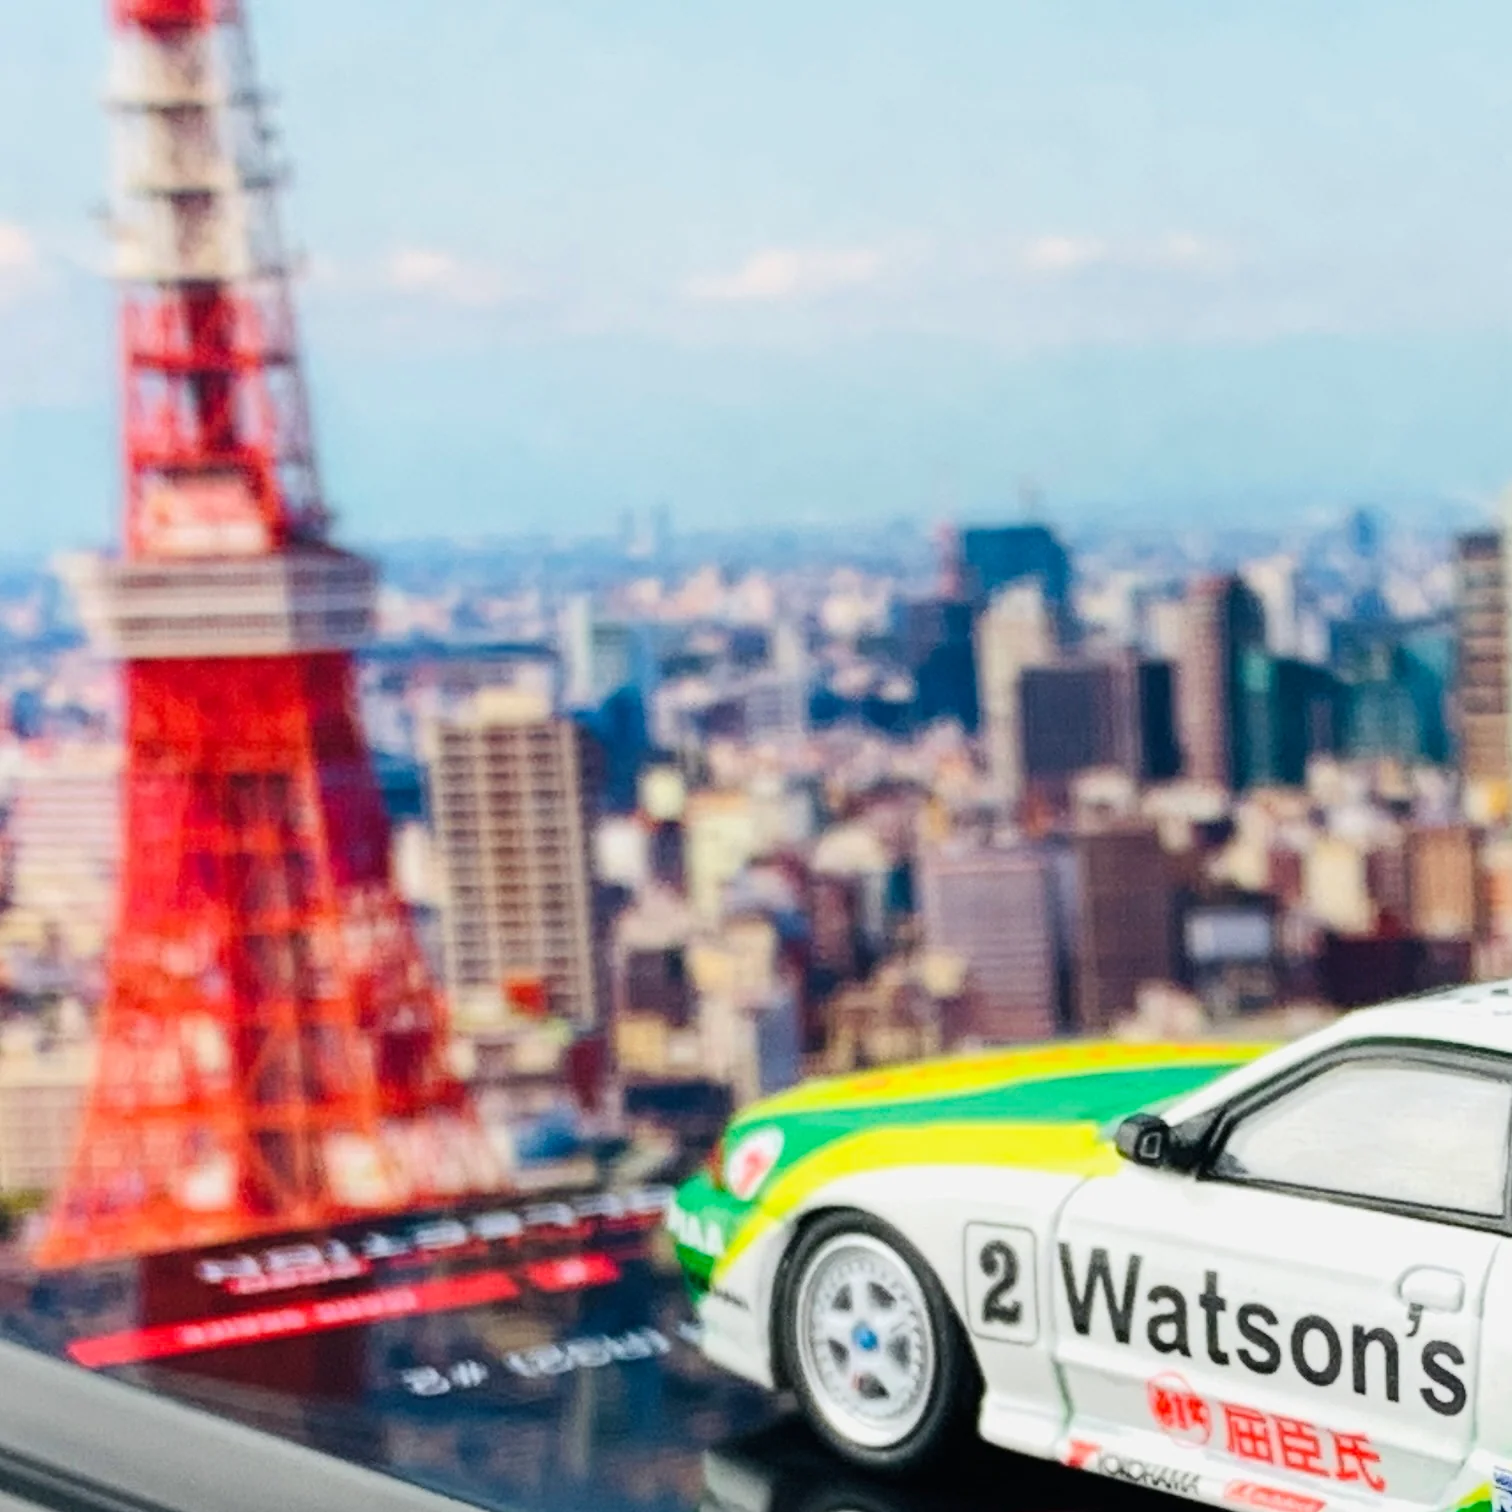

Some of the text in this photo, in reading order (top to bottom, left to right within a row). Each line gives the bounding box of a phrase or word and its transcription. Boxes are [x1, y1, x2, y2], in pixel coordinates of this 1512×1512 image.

[979, 1239, 1021, 1324] 2
[1058, 1242, 1467, 1417] Watson's
[1220, 1402, 1386, 1494] 屈臣氏
